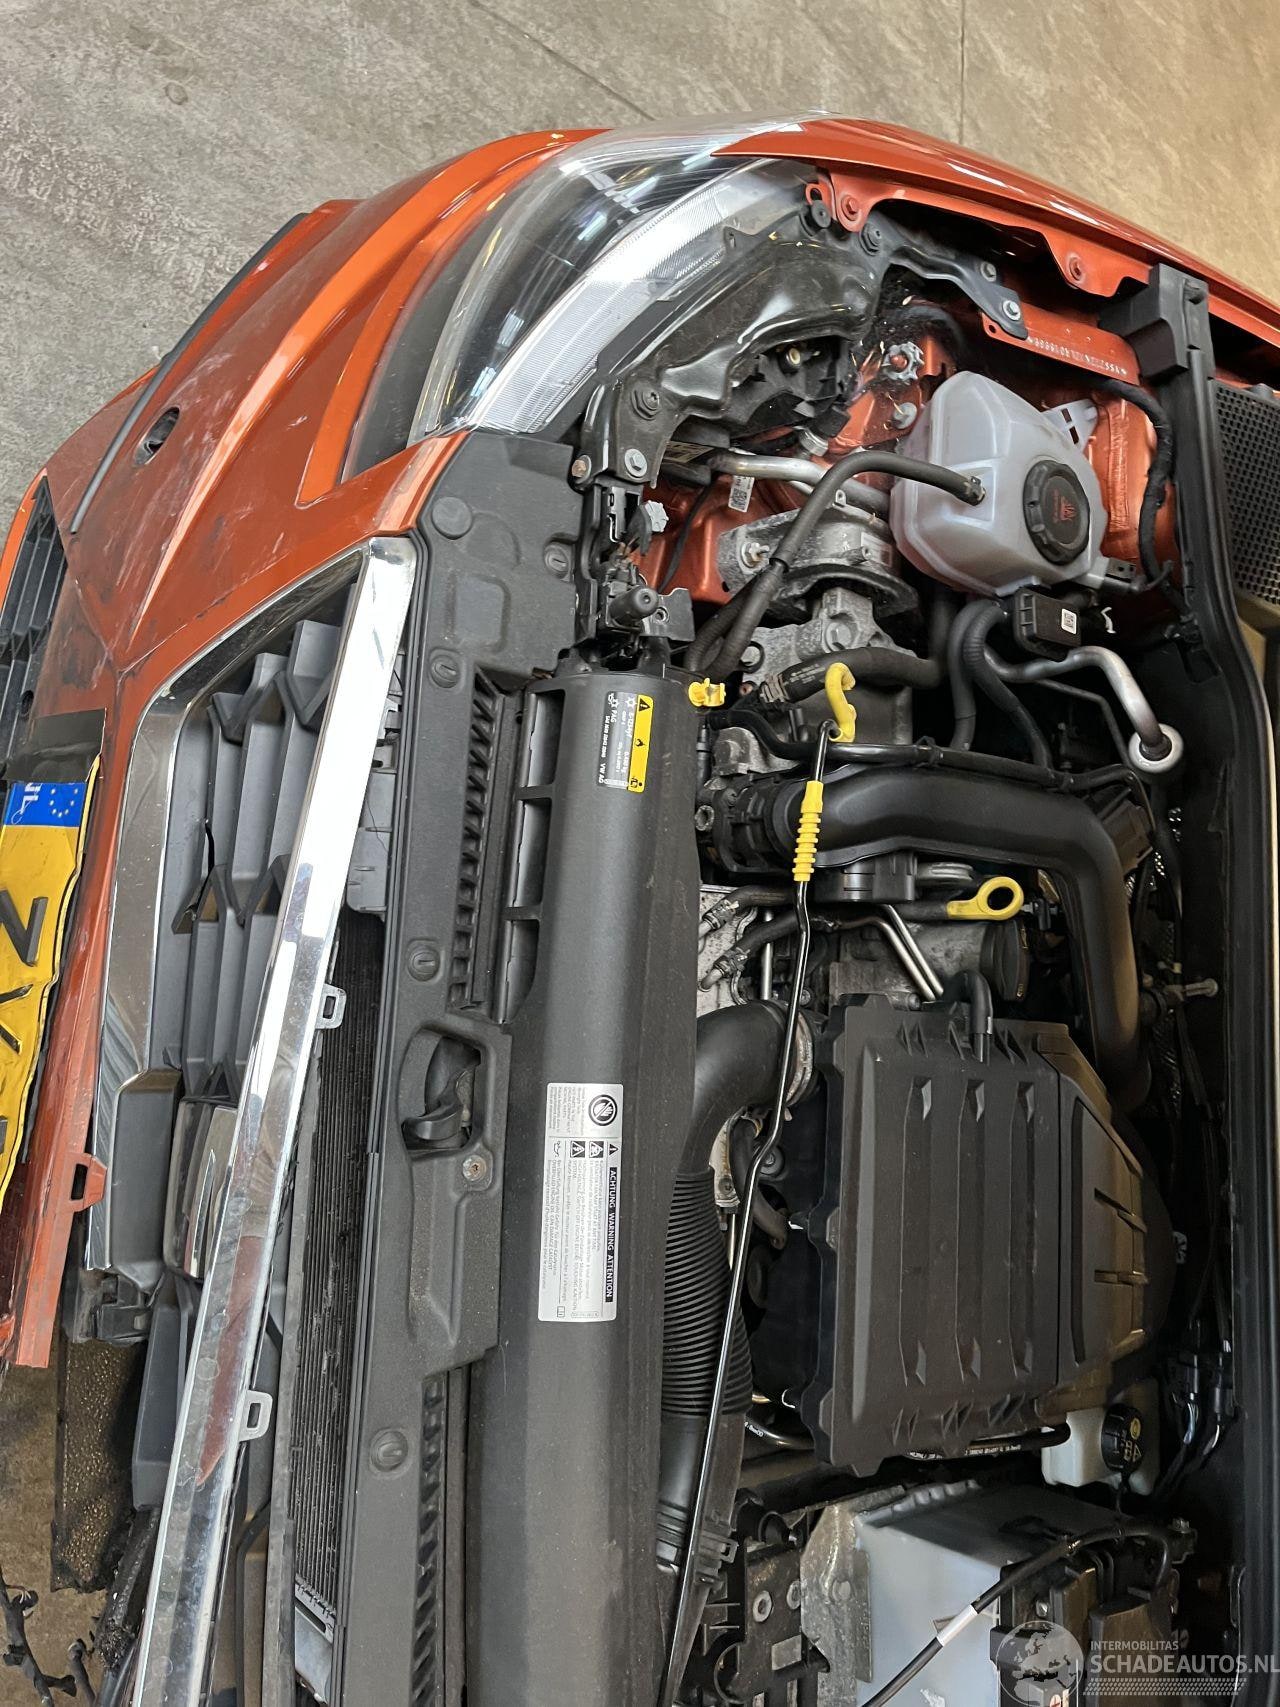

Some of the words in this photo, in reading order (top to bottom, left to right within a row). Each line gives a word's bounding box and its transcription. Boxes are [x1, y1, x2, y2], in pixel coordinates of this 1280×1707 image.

[599, 763, 606, 774] VW
[609, 1170, 617, 1208] ACHTUNG
[608, 1212, 616, 1250] WARNING
[606, 1254, 614, 1296] ATTENTION
